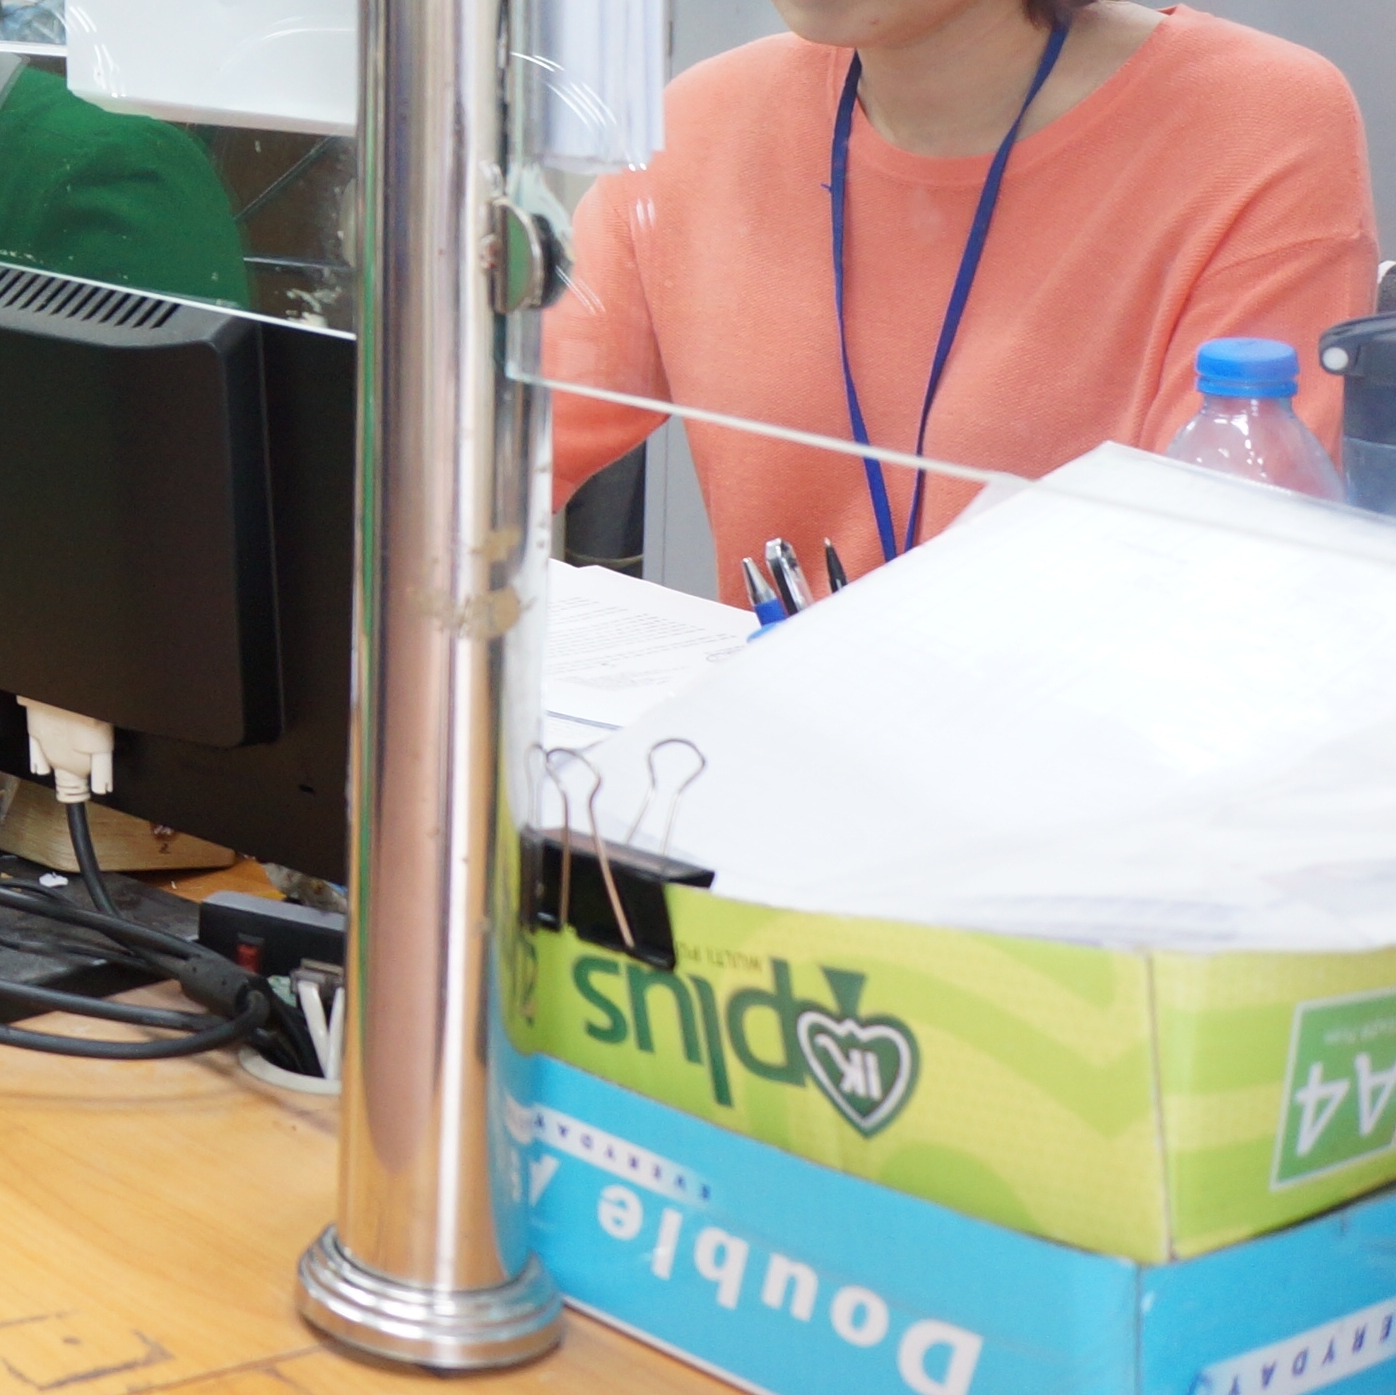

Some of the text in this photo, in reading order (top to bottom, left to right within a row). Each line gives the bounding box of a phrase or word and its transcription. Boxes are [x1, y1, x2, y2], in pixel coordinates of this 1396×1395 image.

[572, 952, 807, 1109] plus
[534, 1111, 712, 1203] EVERYDAY
[1294, 1052, 1396, 1158] A4
[596, 1182, 985, 1395] Double
